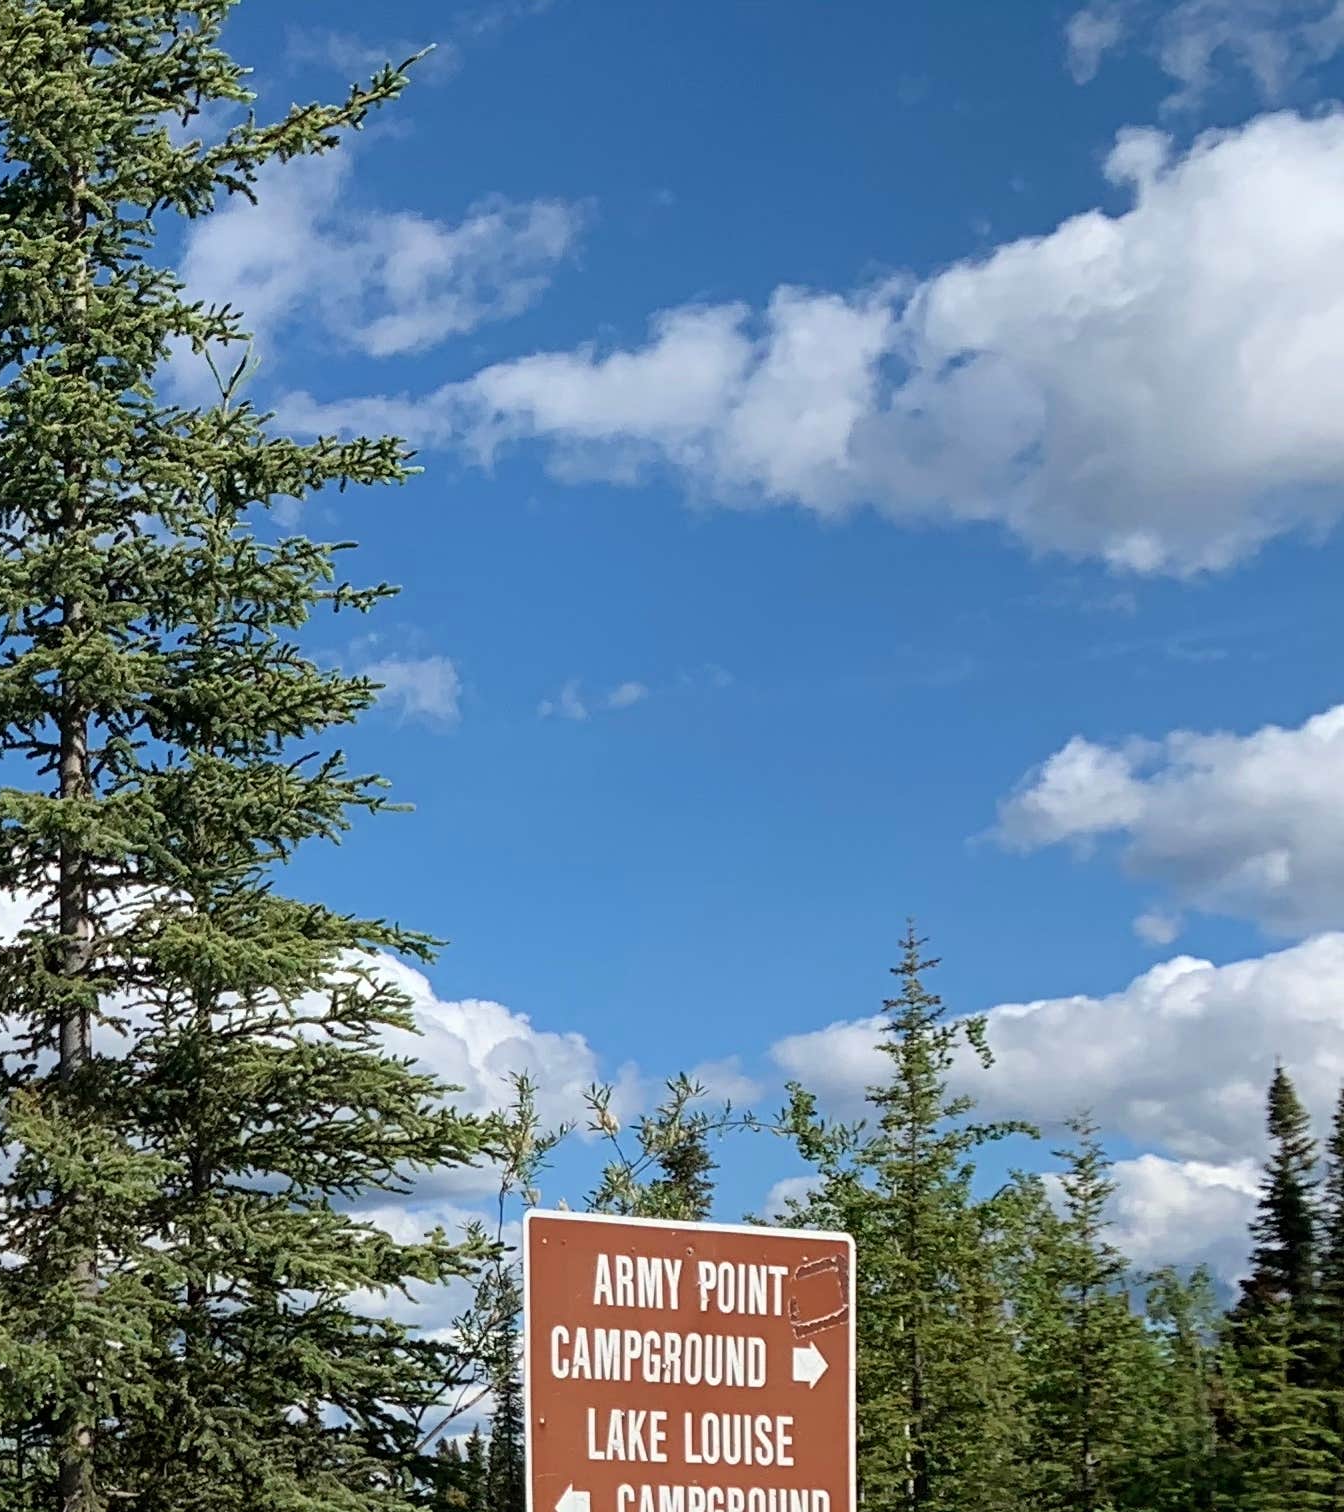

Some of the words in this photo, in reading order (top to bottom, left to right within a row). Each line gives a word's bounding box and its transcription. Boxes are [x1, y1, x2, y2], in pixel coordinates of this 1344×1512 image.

[594, 1254, 682, 1310] ARMY
[698, 1261, 788, 1316] POINT
[551, 1325, 766, 1388] CAMPGROUND
[588, 1408, 667, 1463] LAKE
[684, 1412, 794, 1467] LOUISE
